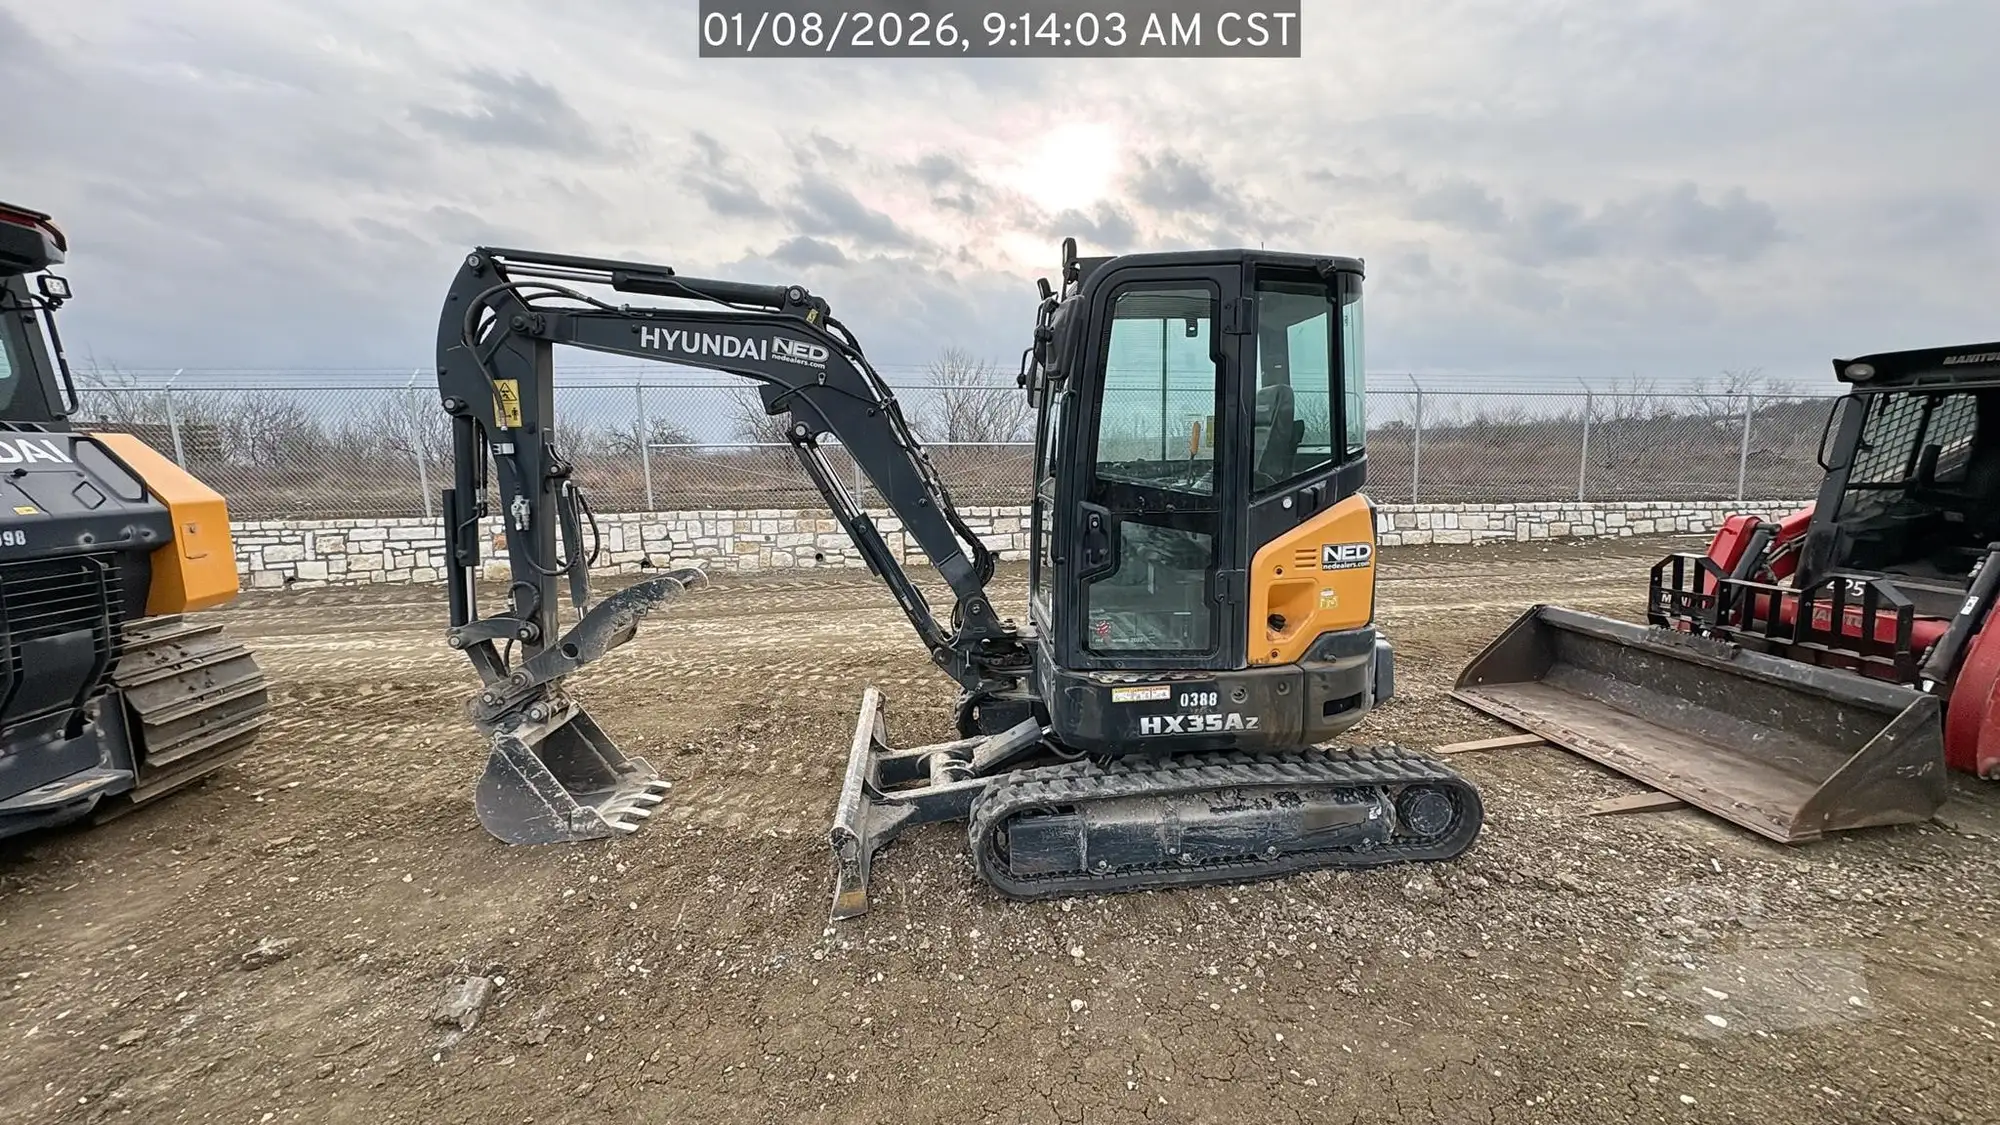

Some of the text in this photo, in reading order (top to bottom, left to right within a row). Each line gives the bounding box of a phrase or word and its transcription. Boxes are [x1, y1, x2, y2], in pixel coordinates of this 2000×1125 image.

[640, 326, 767, 361] HYUNDAI
[771, 336, 830, 362] NED
[771, 353, 826, 370] nedealers.com
[1321, 543, 1373, 562] NED
[1322, 560, 1371, 570] nedealers.com
[1180, 692, 1218, 707] 0388
